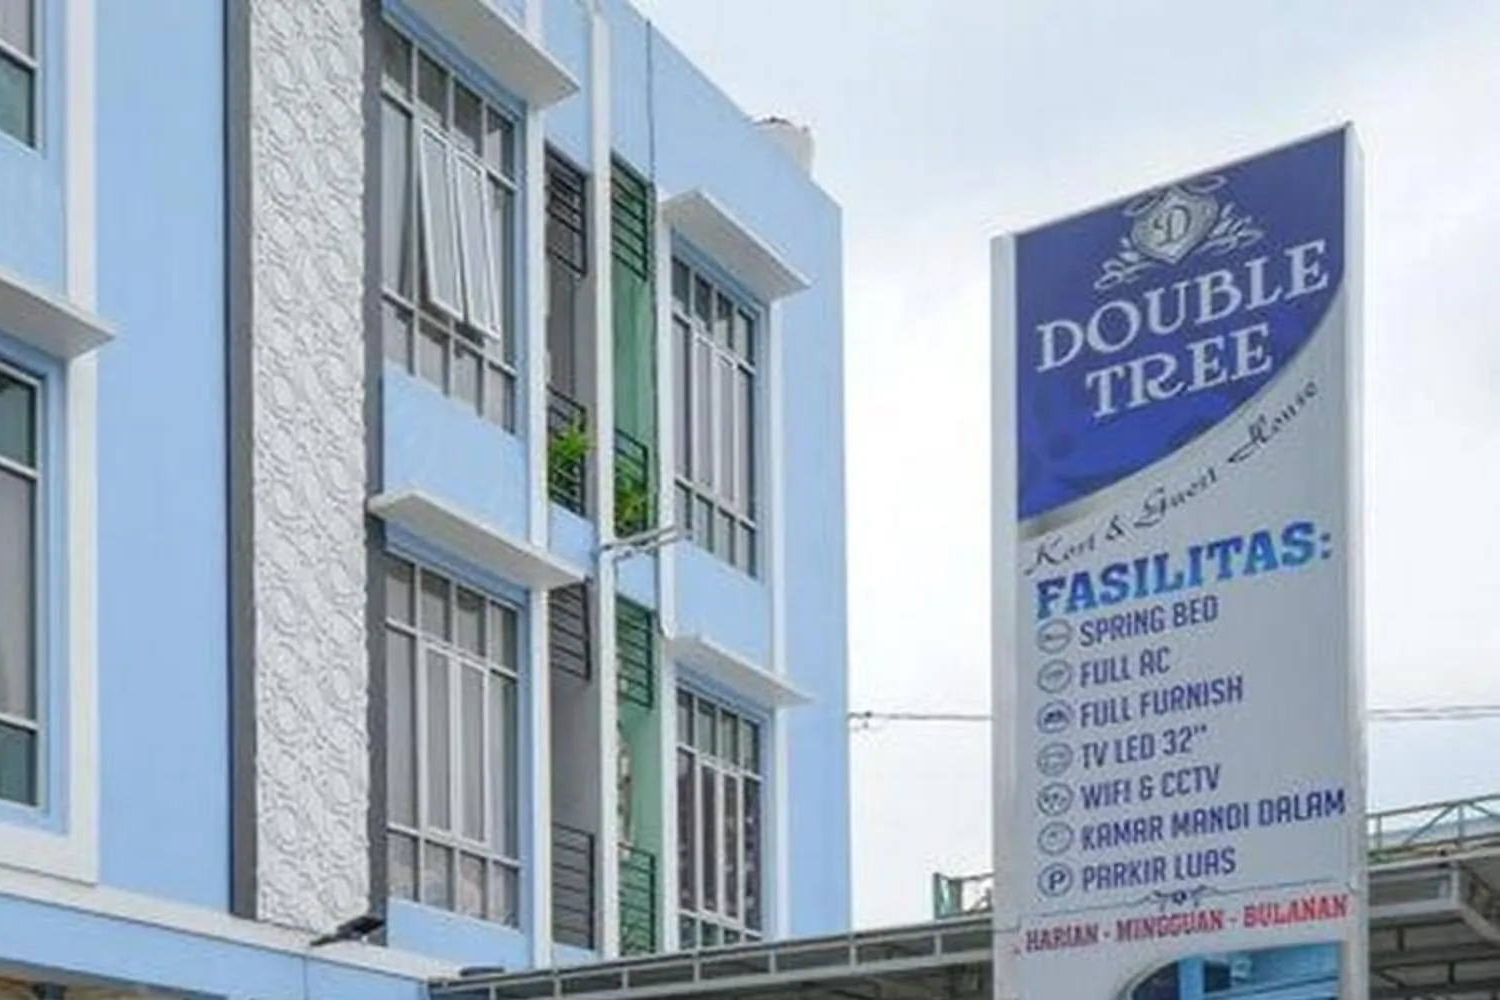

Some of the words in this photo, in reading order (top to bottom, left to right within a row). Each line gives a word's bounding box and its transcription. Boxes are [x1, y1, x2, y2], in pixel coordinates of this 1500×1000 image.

[1035, 239, 1329, 373] DOUBLE
[1085, 322, 1273, 419] TREE
[1036, 521, 1331, 619] FASILITAS:
[1173, 595, 1219, 628] BED
[1079, 655, 1131, 689] FULL
[1139, 646, 1171, 677] AC
[1079, 697, 1132, 729] FULL
[1139, 675, 1244, 718] FURNISH
[1081, 741, 1108, 770] TV
[1115, 733, 1156, 765] LED
[1079, 779, 1132, 810] WIFI
[1161, 763, 1221, 798] CCTV
[1081, 815, 1164, 851] KAMAR
[1171, 803, 1250, 839] MANDI
[1258, 788, 1346, 827] DALAM
[1081, 856, 1167, 892] PARKIR
[1174, 847, 1237, 880] LUAS
[1026, 923, 1099, 953] HARIAN
[1116, 909, 1225, 943] MINGGUAN
[1243, 894, 1348, 928] BULANAN
